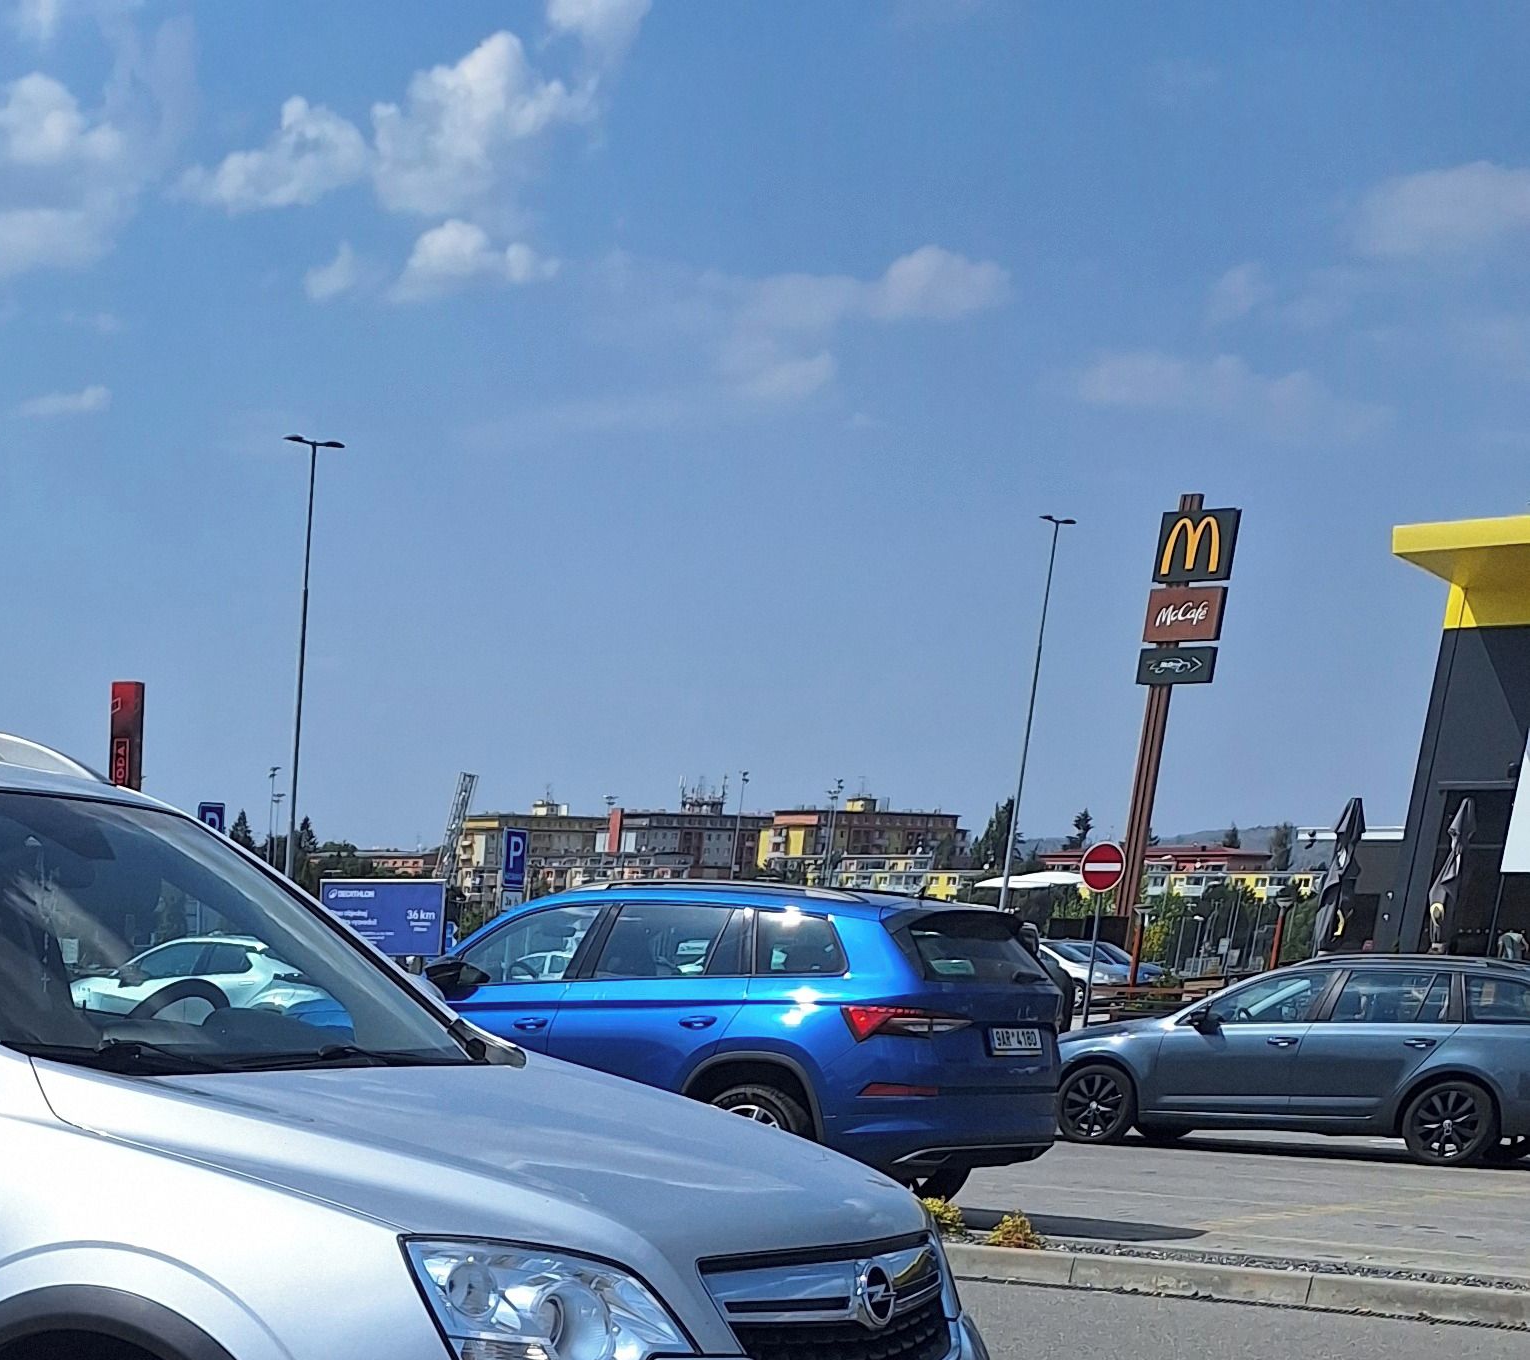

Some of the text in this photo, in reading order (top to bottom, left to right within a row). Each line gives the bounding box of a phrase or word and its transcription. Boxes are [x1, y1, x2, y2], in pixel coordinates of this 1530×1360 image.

[1155, 601, 1209, 627] McCafé
[115, 746, 126, 785] ODA
[509, 836, 524, 869] P
[406, 909, 436, 920] 36 km
